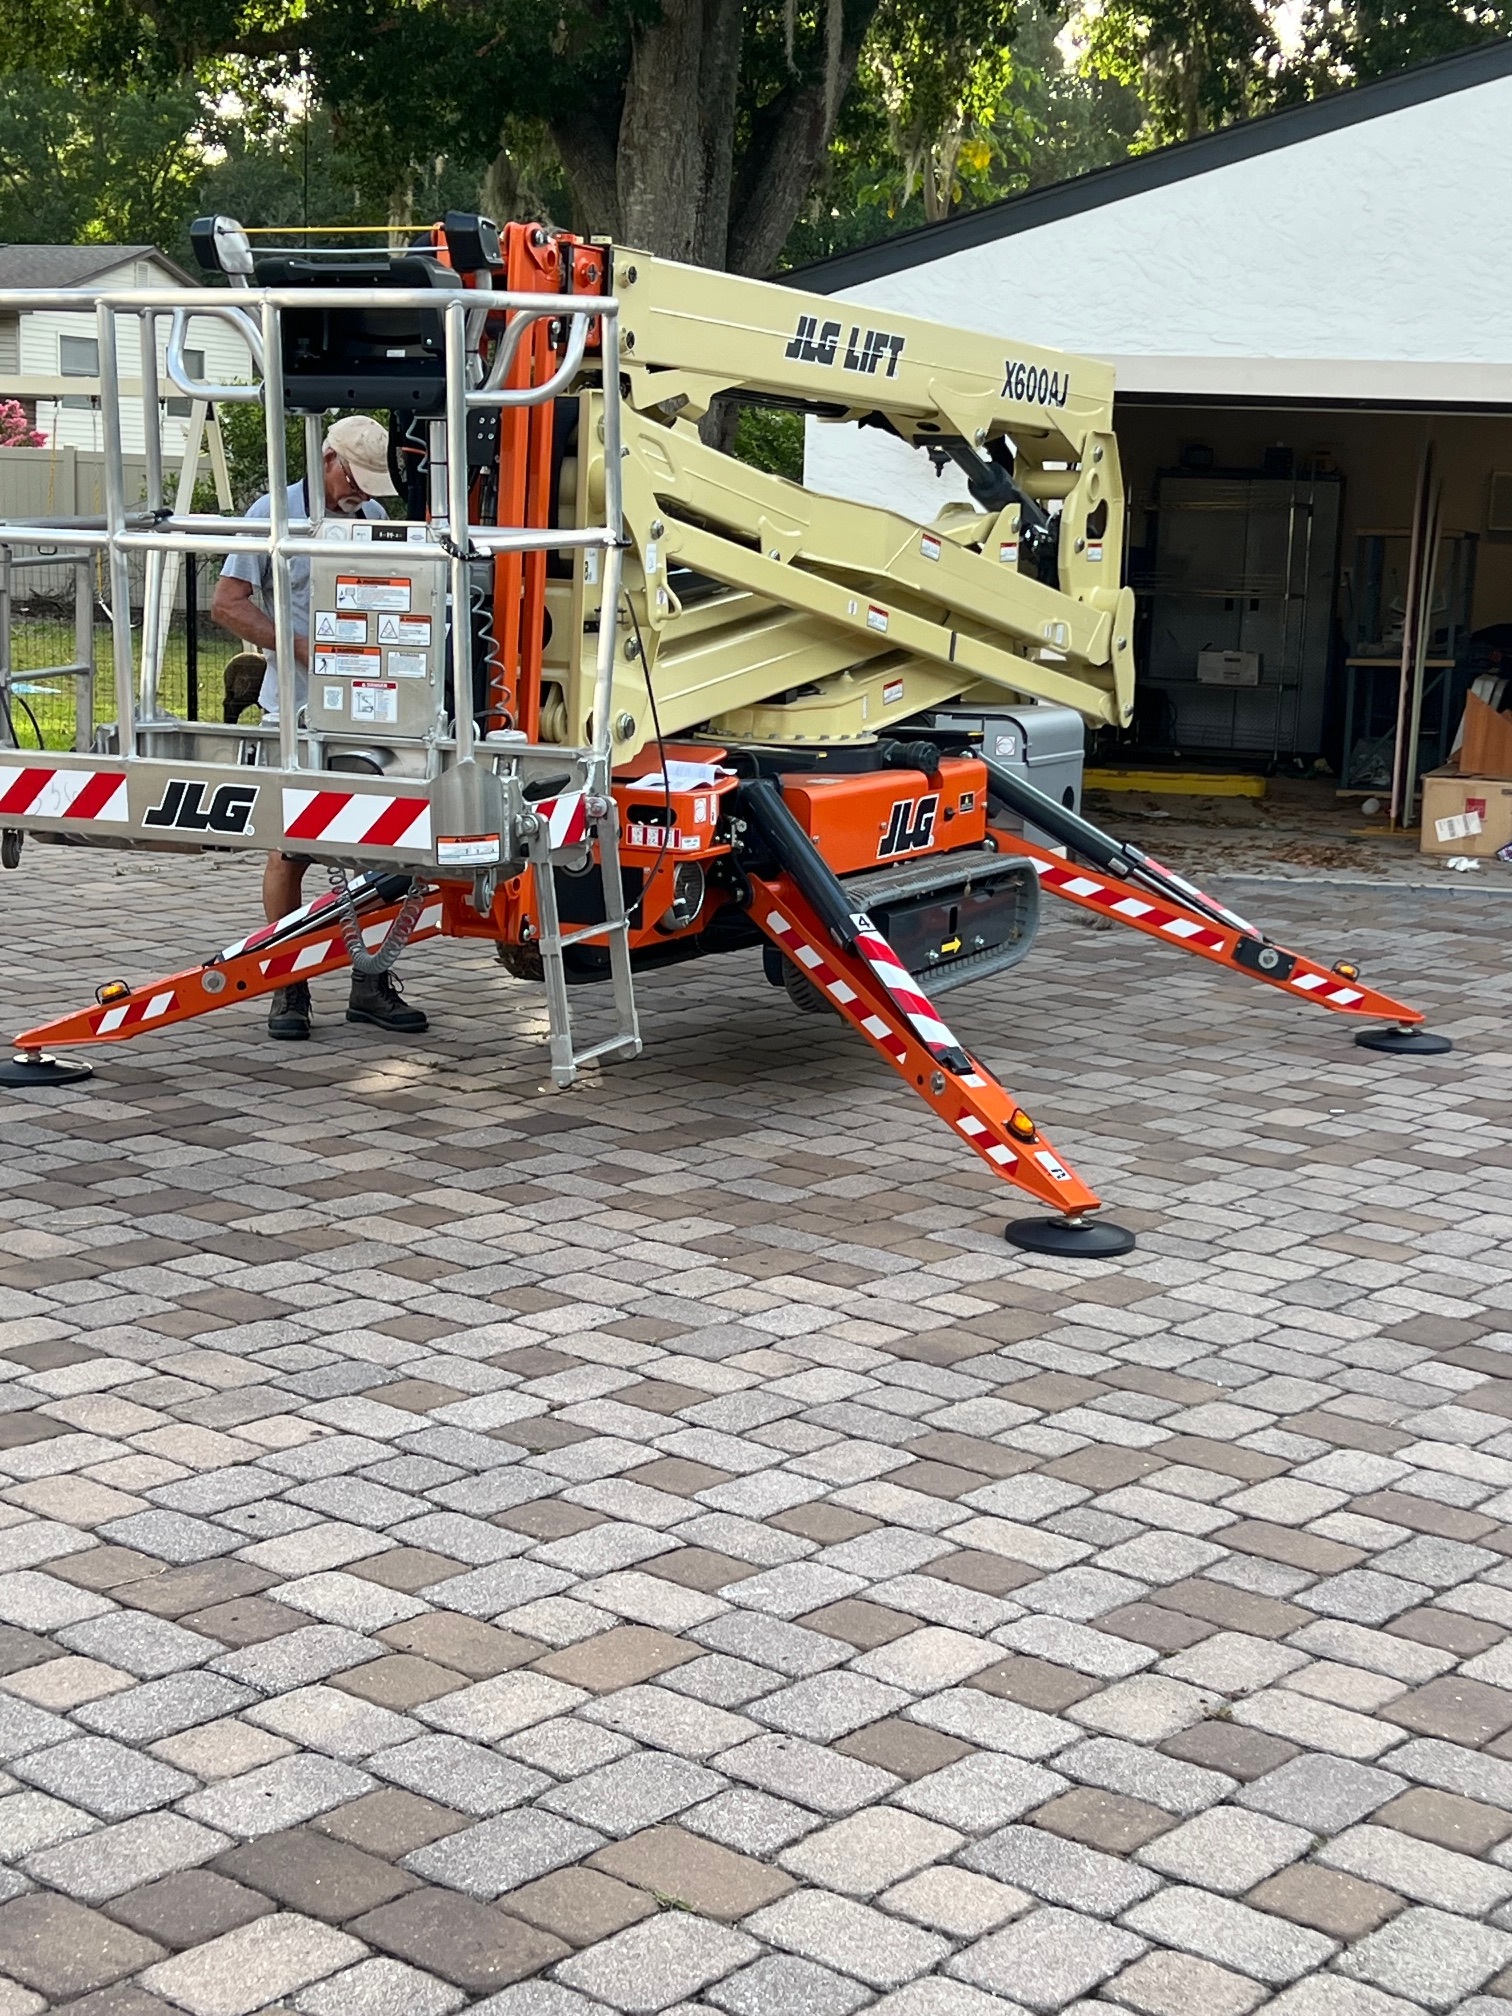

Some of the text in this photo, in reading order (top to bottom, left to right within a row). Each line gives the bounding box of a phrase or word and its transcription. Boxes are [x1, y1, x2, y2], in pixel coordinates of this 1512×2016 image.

[784, 314, 906, 379] JLG LIFT
[1000, 360, 1070, 408] X600AJ
[142, 779, 260, 836] JLG
[877, 793, 940, 859] JLG
[858, 915, 871, 928] 4
